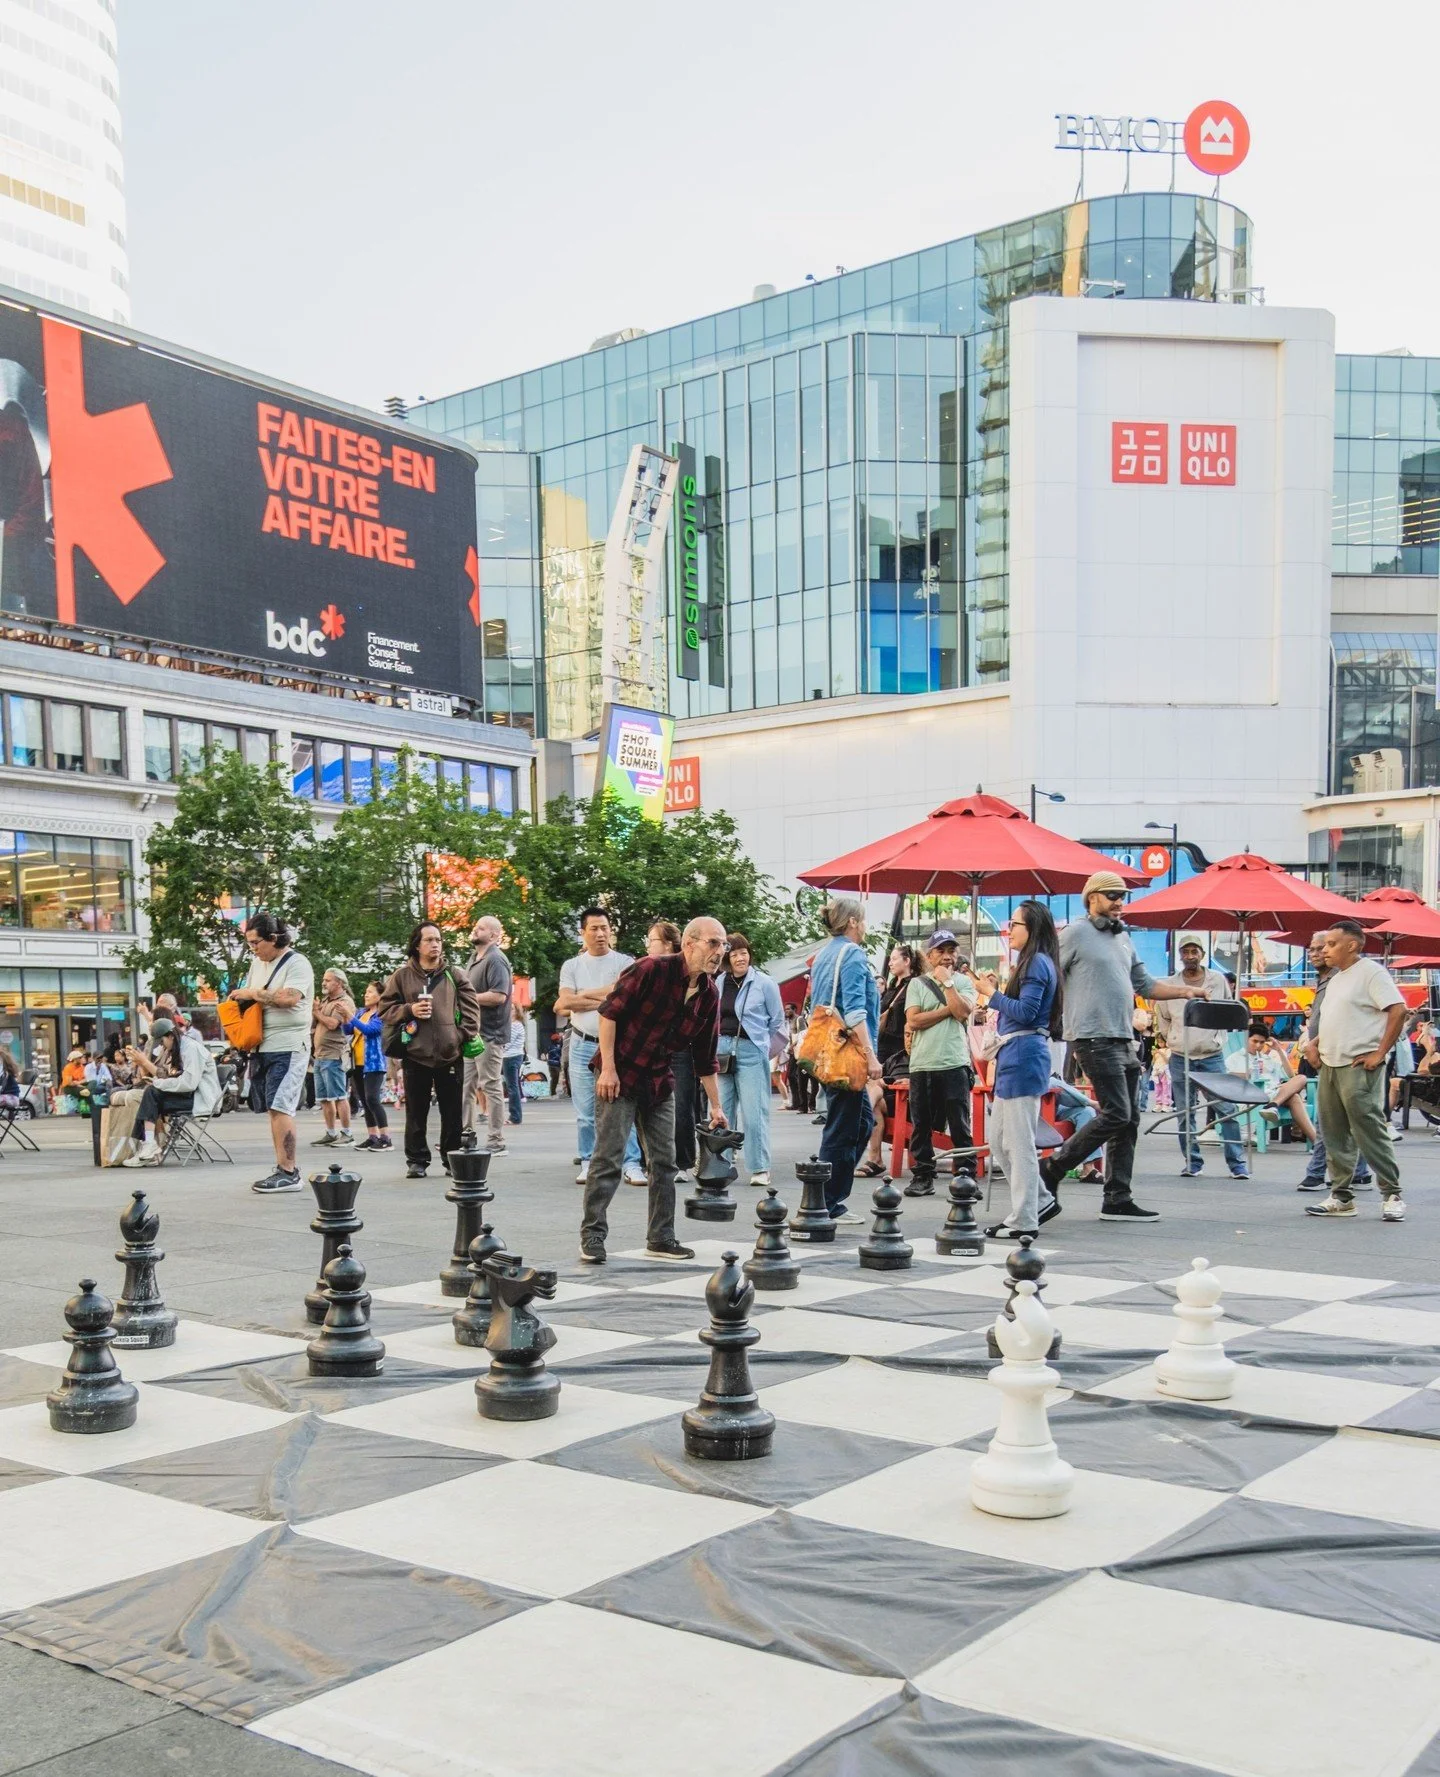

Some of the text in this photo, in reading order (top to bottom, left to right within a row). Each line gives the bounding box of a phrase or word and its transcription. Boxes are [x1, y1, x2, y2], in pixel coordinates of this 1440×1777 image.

[1055, 114, 1168, 152] BMO
[257, 401, 436, 493] FAITES-EN
[1120, 429, 1161, 450] ユニ
[1187, 431, 1227, 453] UNI
[1187, 456, 1230, 480] QLO
[257, 447, 380, 519] VOTRE
[261, 494, 415, 569] AFFAIRE.
[683, 474, 699, 625] simons
[266, 611, 327, 657] bdc
[417, 697, 446, 712] astral
[622, 733, 649, 746] #HOT
[619, 755, 658, 771] SUMMER
[621, 744, 657, 760] SQUARE
